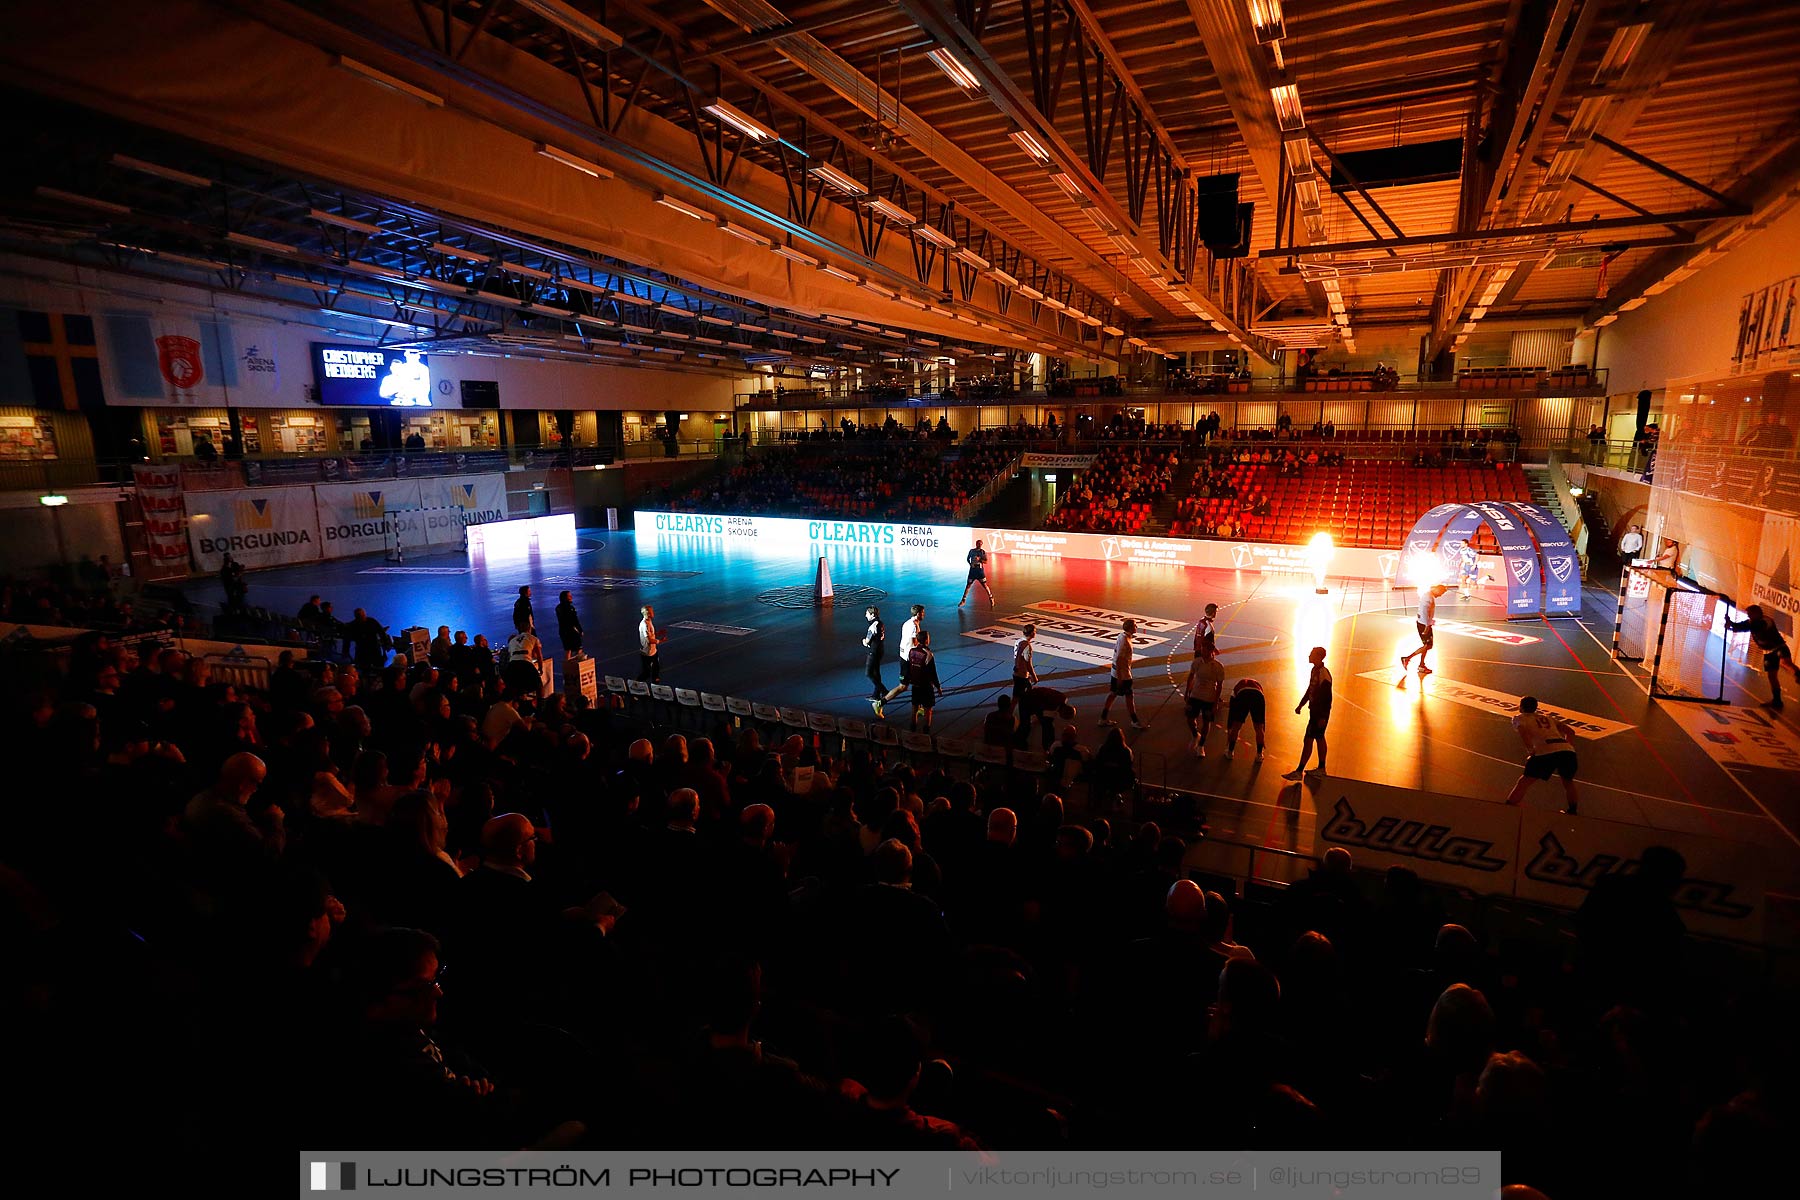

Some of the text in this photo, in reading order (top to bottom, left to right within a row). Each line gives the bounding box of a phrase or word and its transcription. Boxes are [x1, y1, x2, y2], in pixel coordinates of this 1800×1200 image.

[326, 516, 418, 540] BORGUNDA
[428, 509, 504, 530] BORGUNDA
[727, 517, 753, 526] ARENA
[900, 525, 933, 536] ARENA
[200, 529, 311, 554] BORGUNDA
[1066, 607, 1169, 628] PAROC
